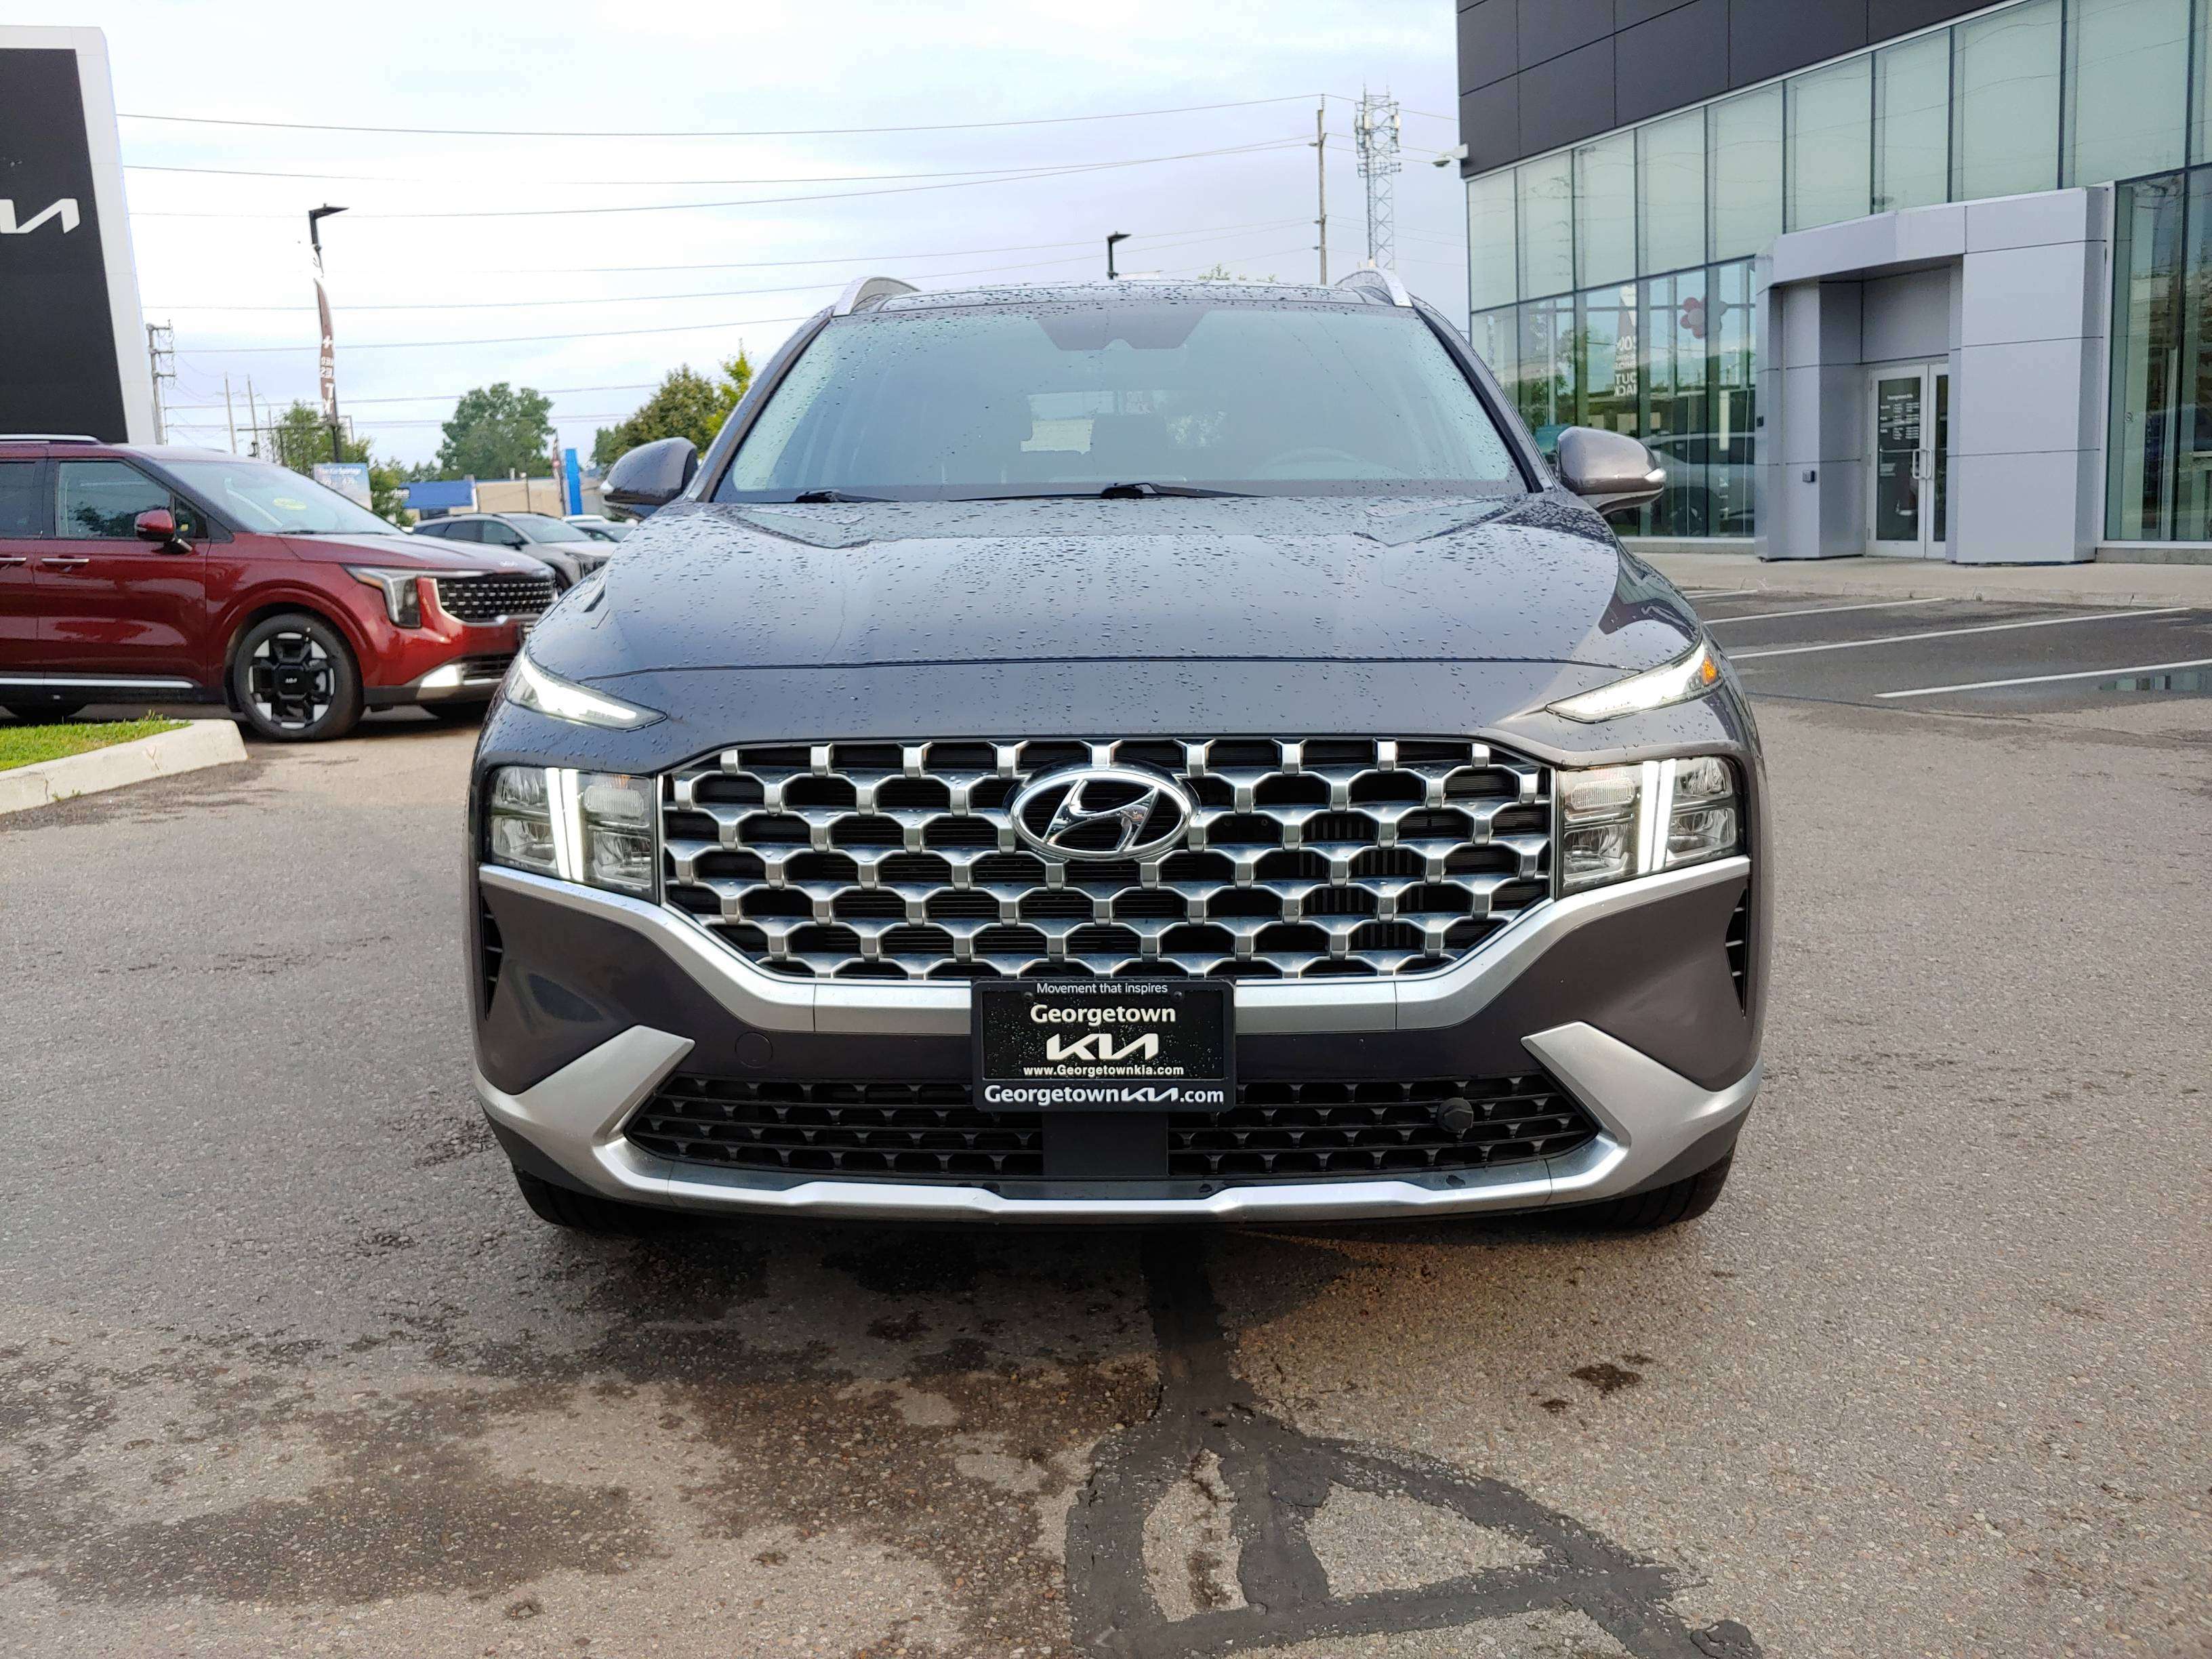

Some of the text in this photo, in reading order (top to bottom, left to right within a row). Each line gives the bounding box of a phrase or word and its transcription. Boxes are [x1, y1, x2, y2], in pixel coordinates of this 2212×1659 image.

[0, 199, 79, 233] IA
[1038, 983, 1168, 995] Movement that inspires
[1031, 1004, 1175, 1026] Georgetown
[1047, 1033, 1158, 1060] KIA
[1023, 1065, 1183, 1076] www.Georgetownkia.com
